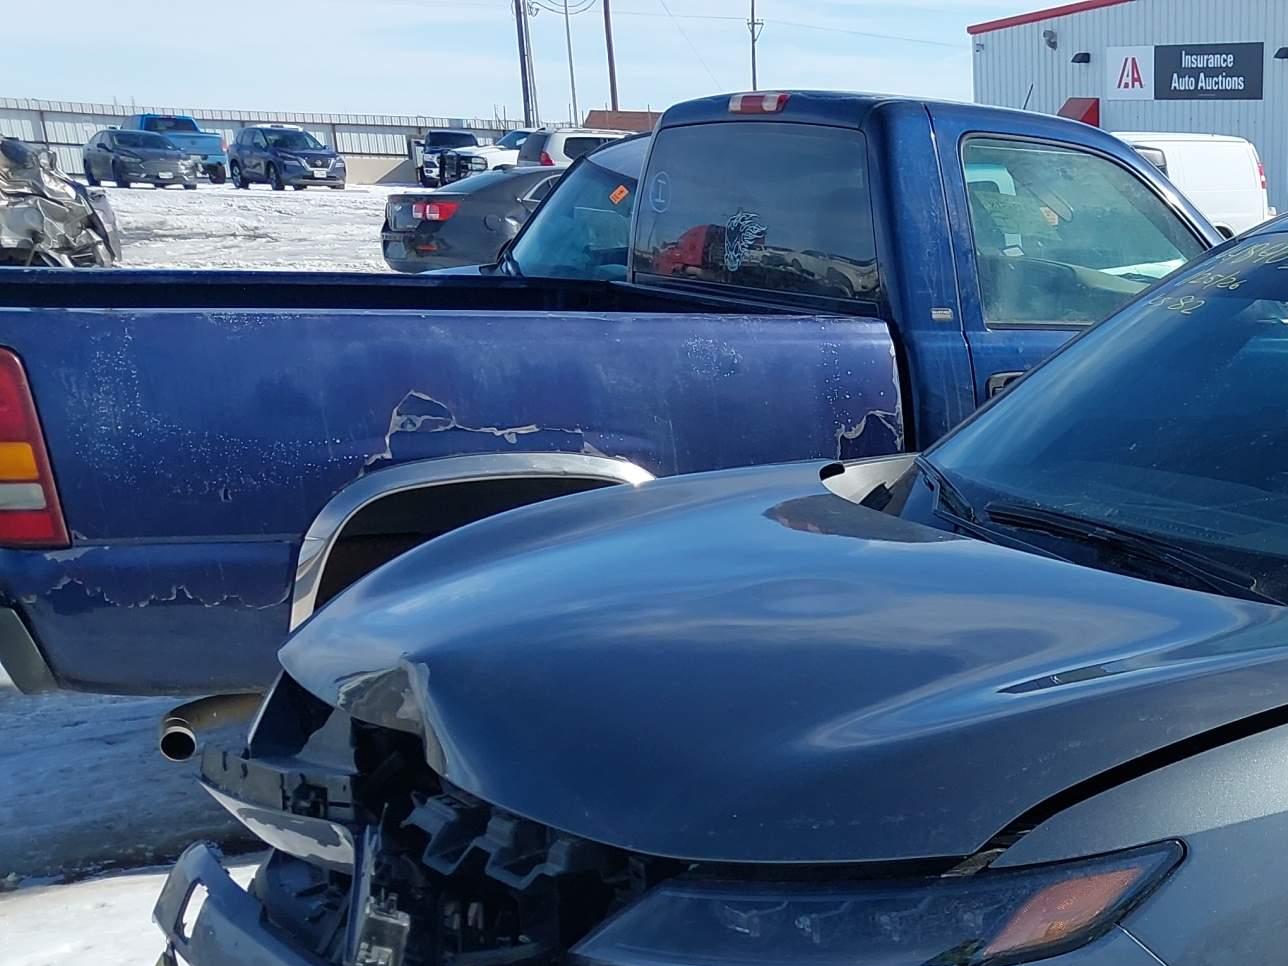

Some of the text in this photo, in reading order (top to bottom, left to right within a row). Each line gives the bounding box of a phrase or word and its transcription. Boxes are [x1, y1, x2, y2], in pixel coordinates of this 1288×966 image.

[1181, 50, 1234, 68] Insurance
[1171, 72, 1245, 90] Auto Auctions
